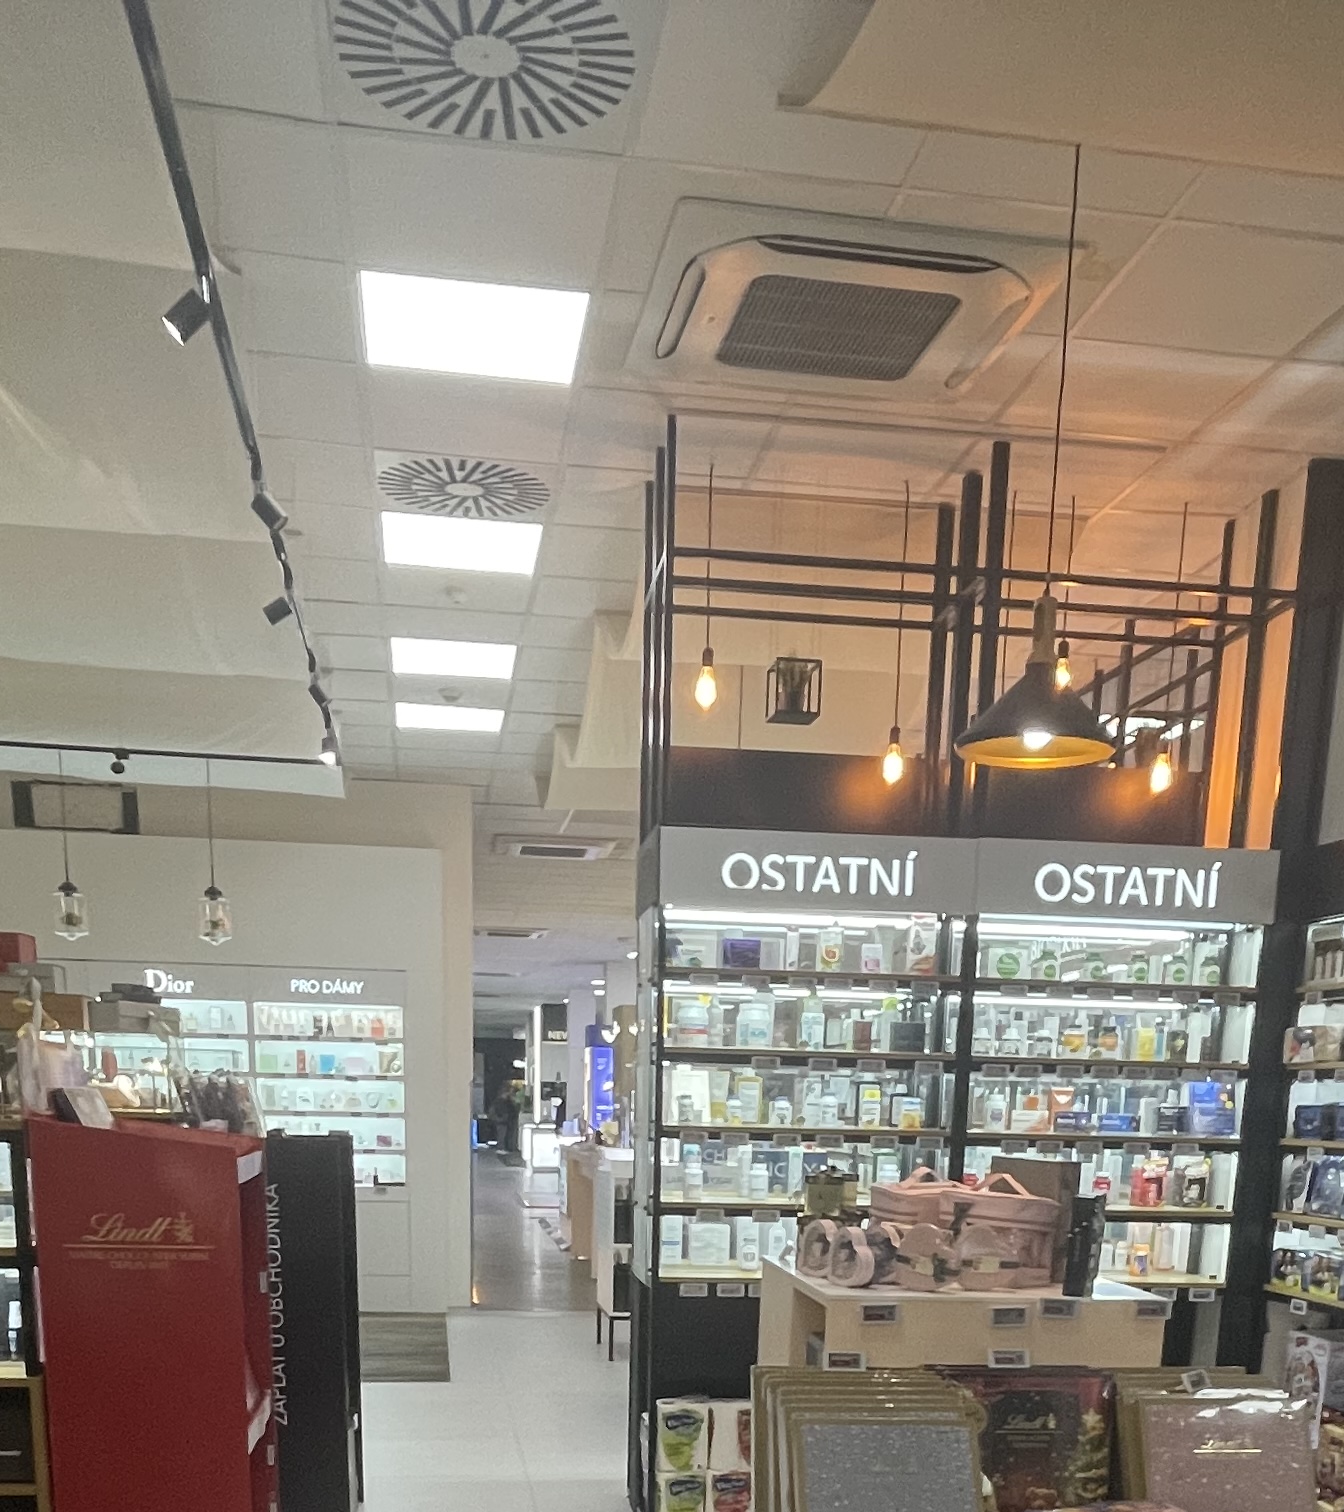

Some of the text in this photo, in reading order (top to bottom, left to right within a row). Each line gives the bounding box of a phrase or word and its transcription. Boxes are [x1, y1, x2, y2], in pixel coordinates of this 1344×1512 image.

[721, 850, 919, 897] OSTATNÍ
[1033, 860, 1223, 908] OSTATNÍ
[143, 967, 195, 994] Dior
[289, 977, 365, 996] PRO DÁMY
[81, 1212, 173, 1243] Lindt
[270, 1333, 286, 1348] U
